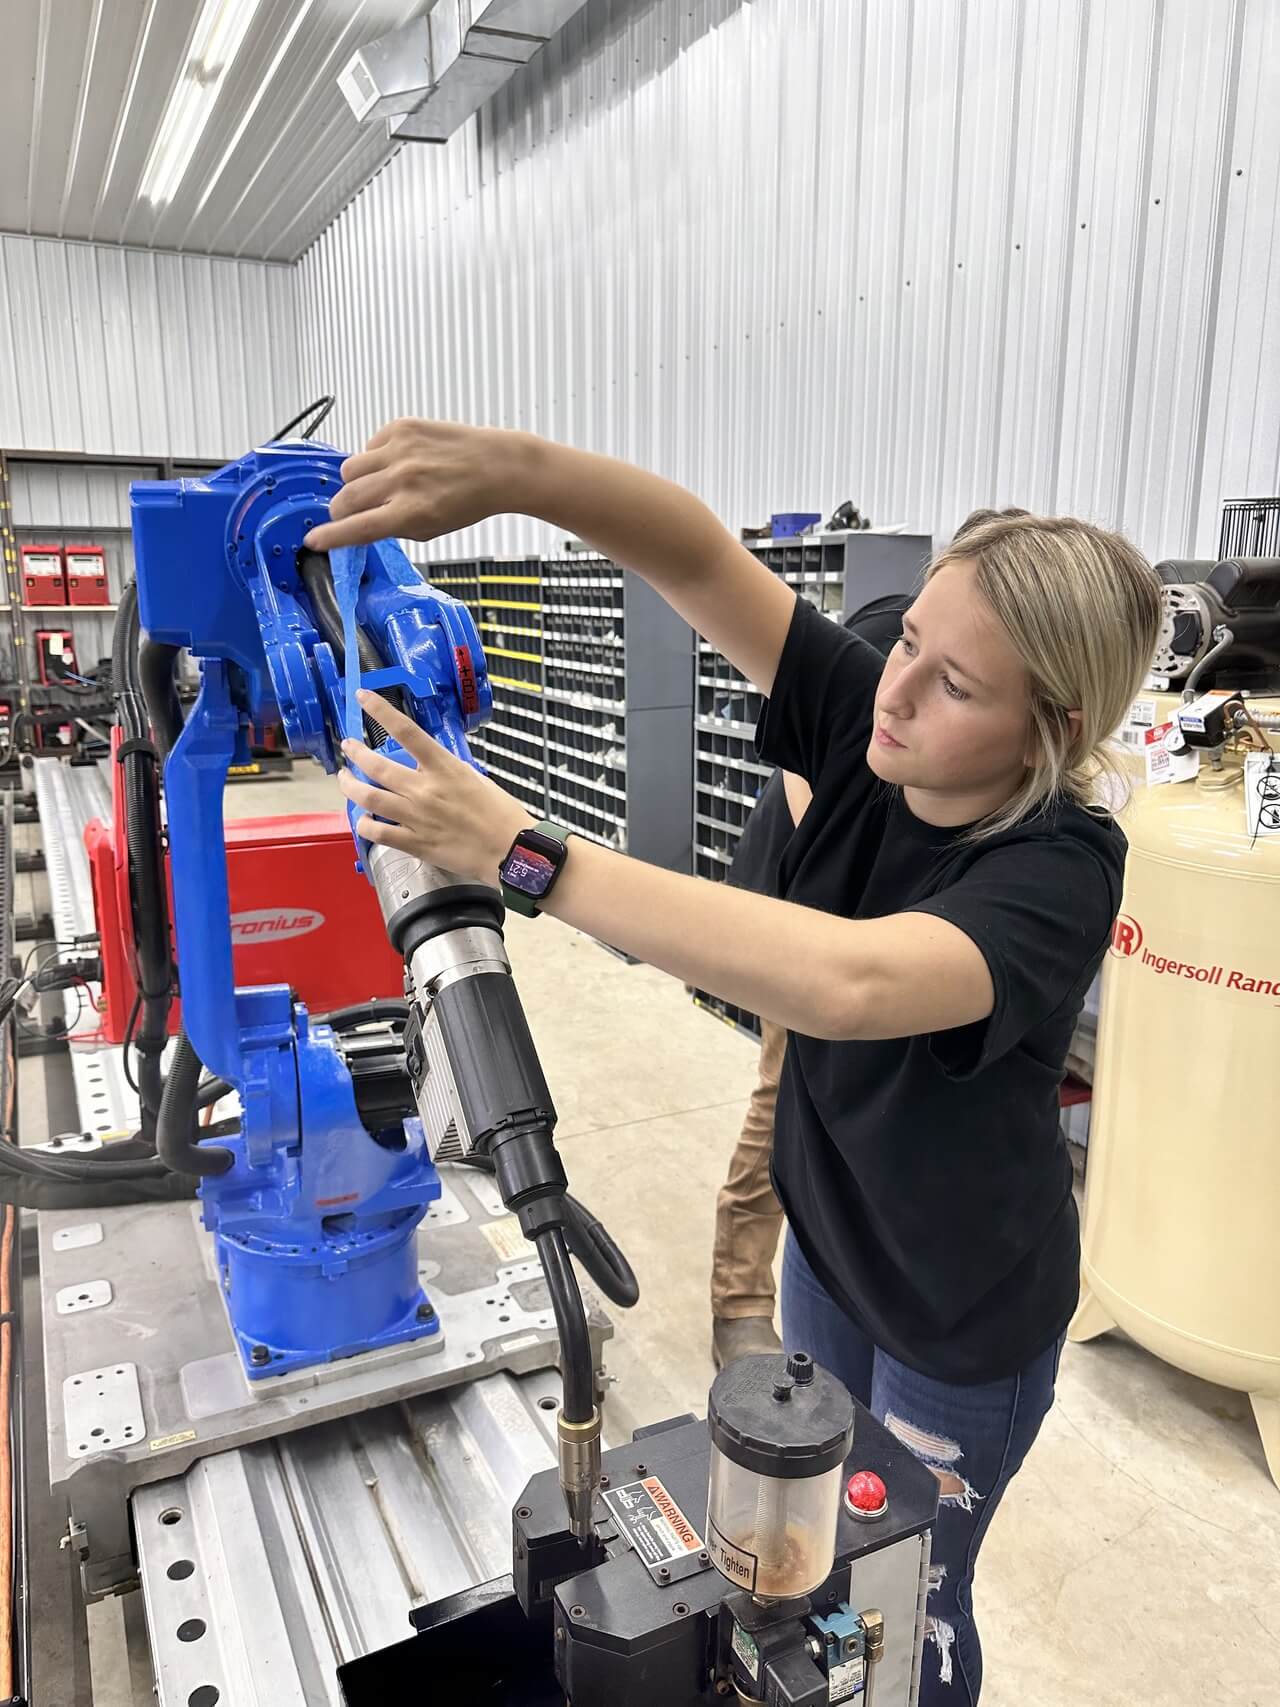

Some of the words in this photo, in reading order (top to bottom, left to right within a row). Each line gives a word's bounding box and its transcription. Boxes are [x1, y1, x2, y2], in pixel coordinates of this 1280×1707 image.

[1142, 948, 1223, 985] Ingersoll
[653, 1490, 694, 1543] WARNING
[720, 1547, 750, 1579] Tighten
